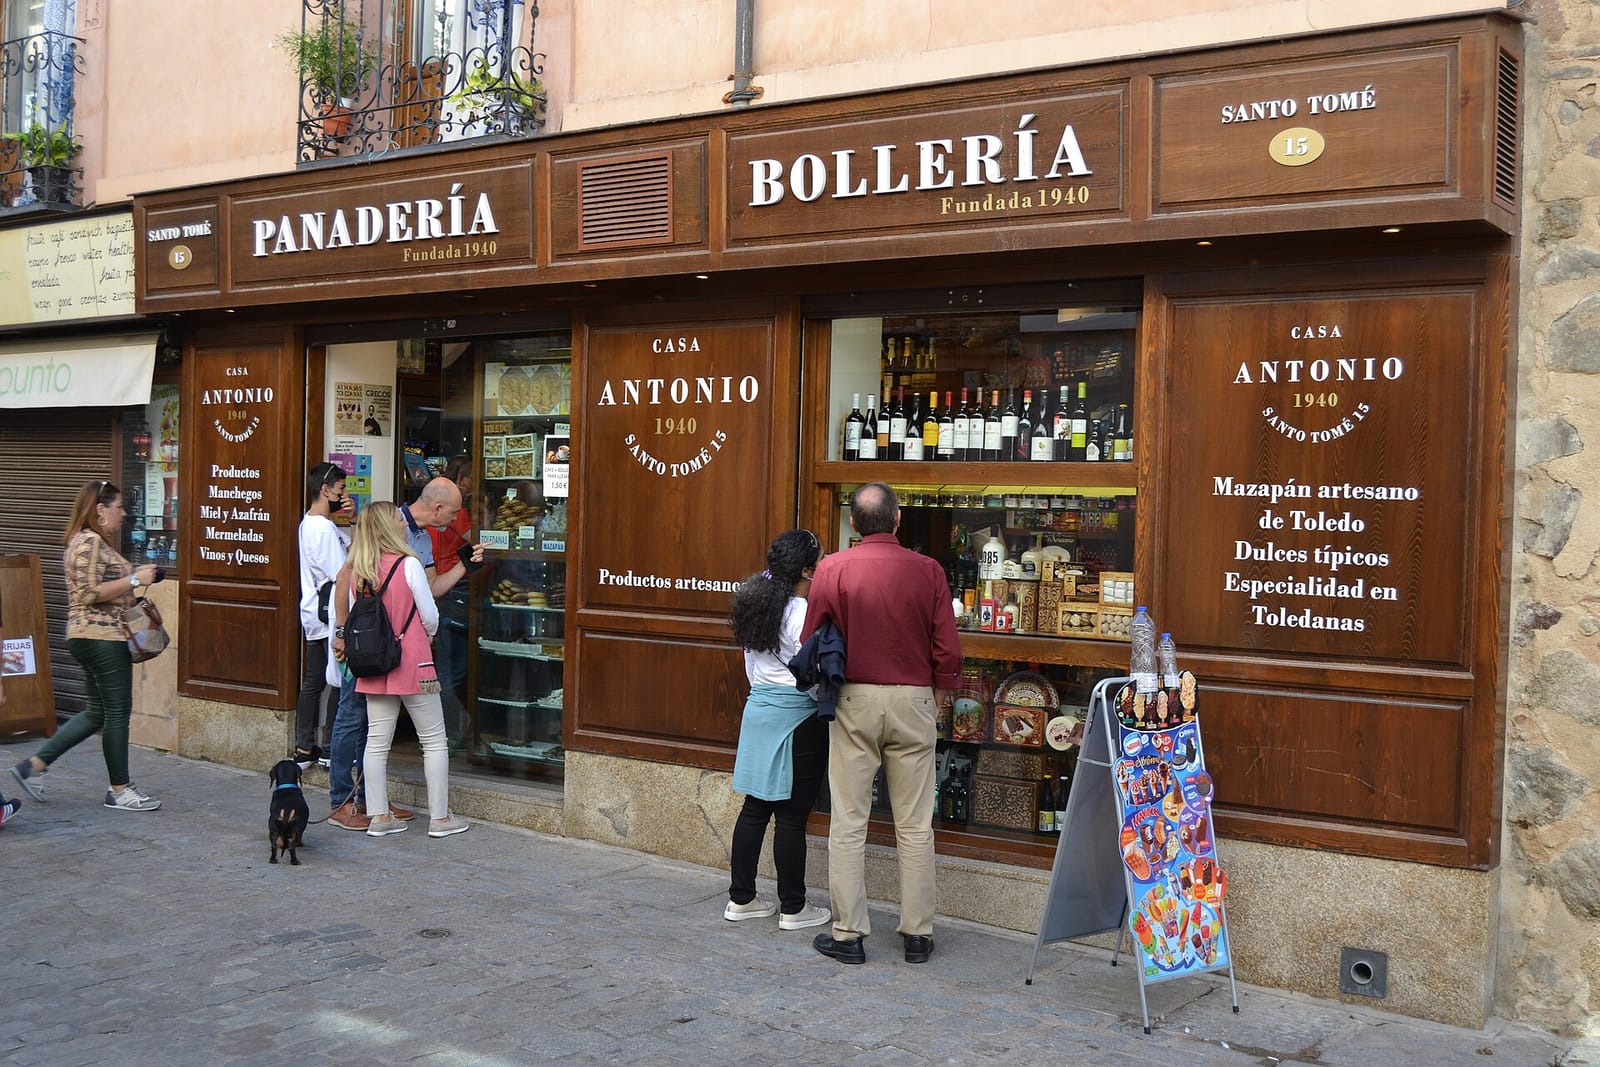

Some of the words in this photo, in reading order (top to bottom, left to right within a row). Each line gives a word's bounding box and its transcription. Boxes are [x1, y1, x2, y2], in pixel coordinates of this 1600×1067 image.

[1221, 98, 1298, 124] SANTO
[1307, 84, 1376, 115] TOMÉ
[1283, 137, 1309, 156] 15
[748, 113, 1093, 207] BOLLERÍA
[940, 193, 1032, 215] Fundada
[1038, 186, 1090, 208] 1940
[148, 226, 179, 242] SANTO
[183, 220, 212, 238] TOMÉ
[252, 183, 500, 257] PANADERÍA
[173, 252, 185, 264] 15
[402, 244, 462, 263] Fundada
[464, 241, 497, 257] 1940
[1291, 325, 1342, 340] CASA
[652, 337, 701, 353] CASA
[226, 367, 249, 376] CASA
[1232, 357, 1403, 384] ANTONIO
[201, 387, 274, 405] ANTONIO
[597, 375, 759, 406] ANTONIO
[1293, 392, 1338, 408] 1940
[227, 410, 247, 420] 1940
[655, 417, 697, 435] 1940
[1261, 406, 1305, 442] SANTO
[1310, 417, 1354, 444] TOMÉ
[1352, 402, 1370, 422] 15
[213, 419, 233, 442] SANTO
[234, 426, 253, 443] TOMÉ
[251, 416, 260, 429] 15
[624, 433, 666, 475] SANTO
[670, 447, 712, 478] TOMÉ
[710, 429, 727, 452] 15
[211, 465, 260, 479] Productos
[208, 485, 263, 504] Manchegos
[1212, 476, 1312, 504] Mazapán
[1317, 482, 1419, 501] artesano
[200, 506, 221, 519] Miel
[222, 510, 229, 523] y
[230, 507, 270, 521] Azafrán
[1258, 509, 1284, 530] de
[1289, 510, 1365, 533] Toledo
[205, 526, 264, 543] Mermeladas
[199, 547, 226, 561] Vinos
[227, 552, 234, 565] y
[235, 549, 270, 565] Quesos
[1233, 540, 1308, 563] Dulces
[1313, 545, 1389, 572] típicos
[598, 568, 672, 588] Productos
[674, 576, 744, 593] artesano
[1223, 572, 1364, 599] Especialidad
[1370, 585, 1398, 601] en
[1251, 605, 1365, 632] Toledanas
